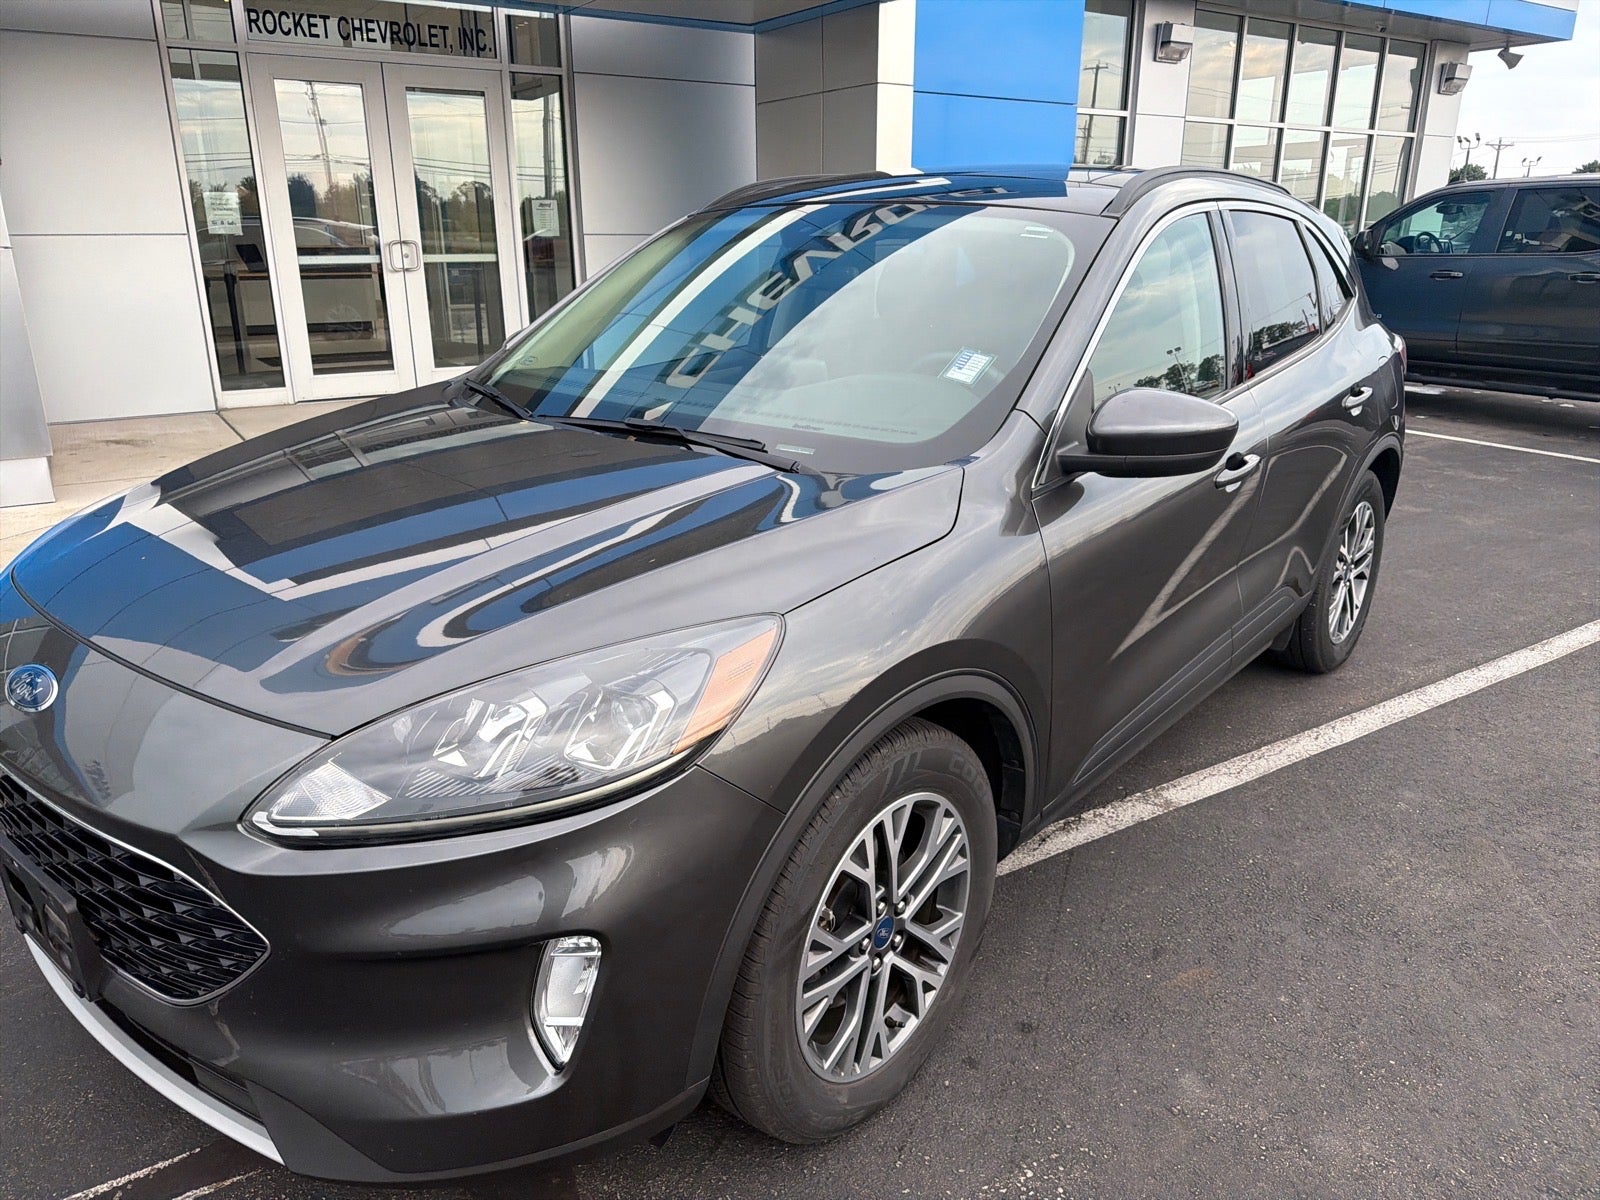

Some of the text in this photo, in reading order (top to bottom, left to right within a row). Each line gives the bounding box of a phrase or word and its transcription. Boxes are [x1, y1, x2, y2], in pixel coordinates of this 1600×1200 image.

[247, 8, 492, 53] ROCKET CHEVROLET, INC.
[11, 671, 43, 701] Ford
